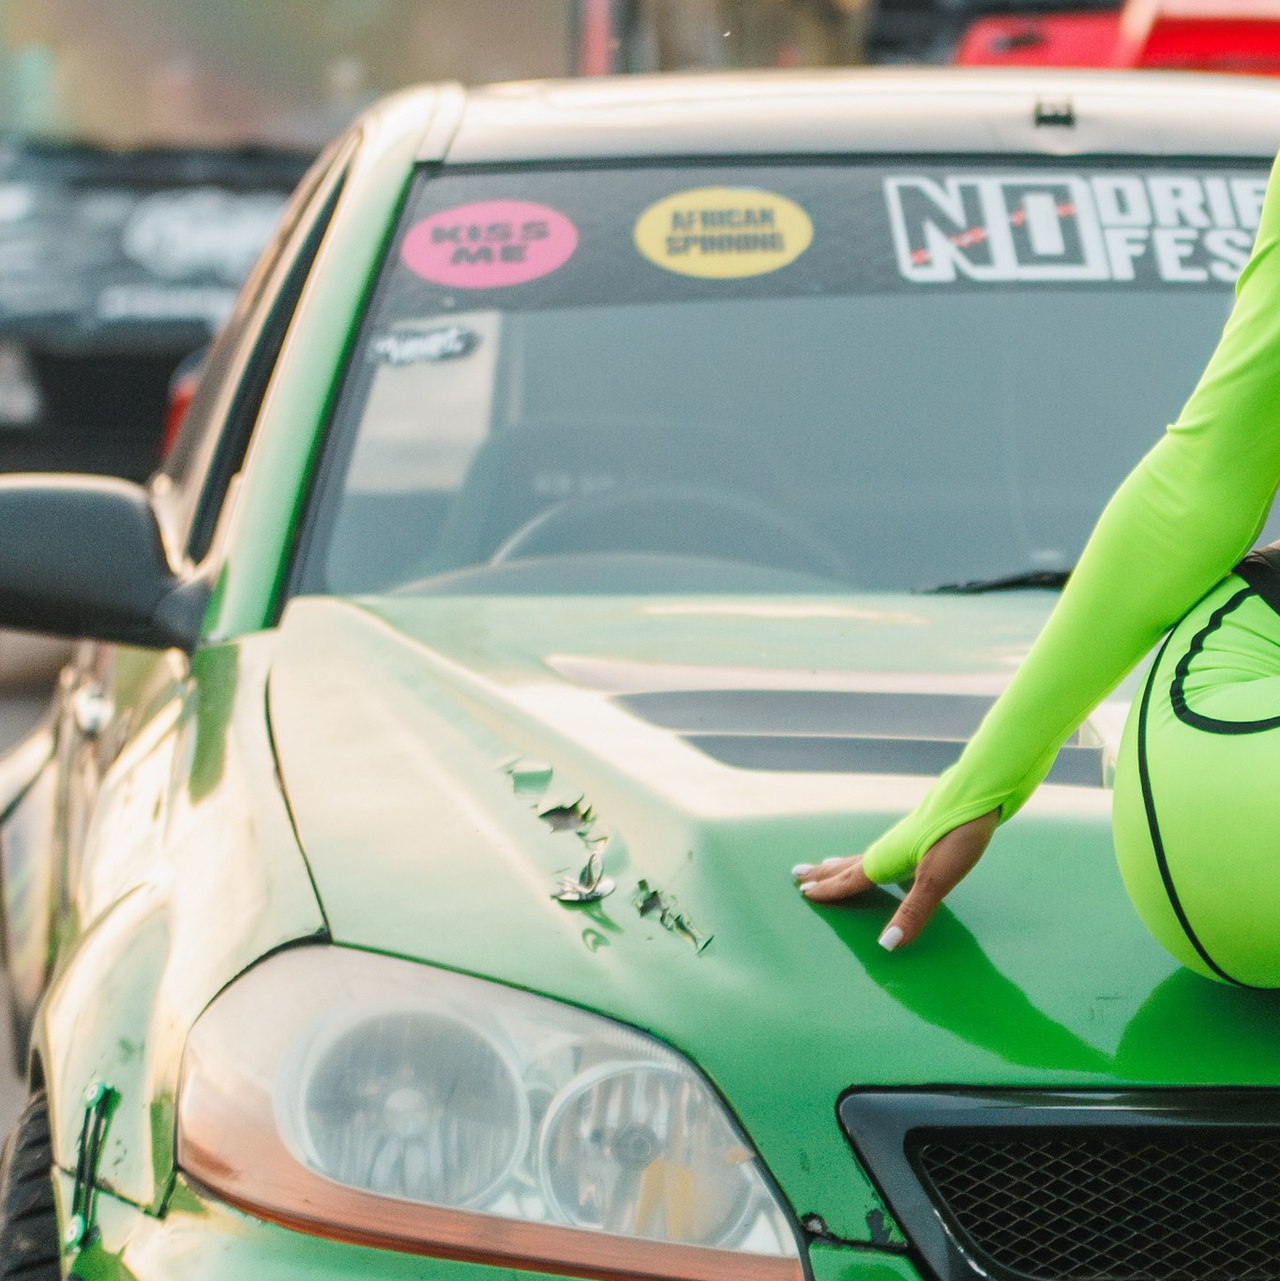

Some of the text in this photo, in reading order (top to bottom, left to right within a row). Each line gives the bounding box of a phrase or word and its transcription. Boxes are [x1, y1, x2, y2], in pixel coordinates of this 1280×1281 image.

[1091, 176, 1271, 228] DRIF
[430, 220, 551, 246] KISS
[450, 244, 528, 267] ME
[1104, 227, 1257, 283] FES
